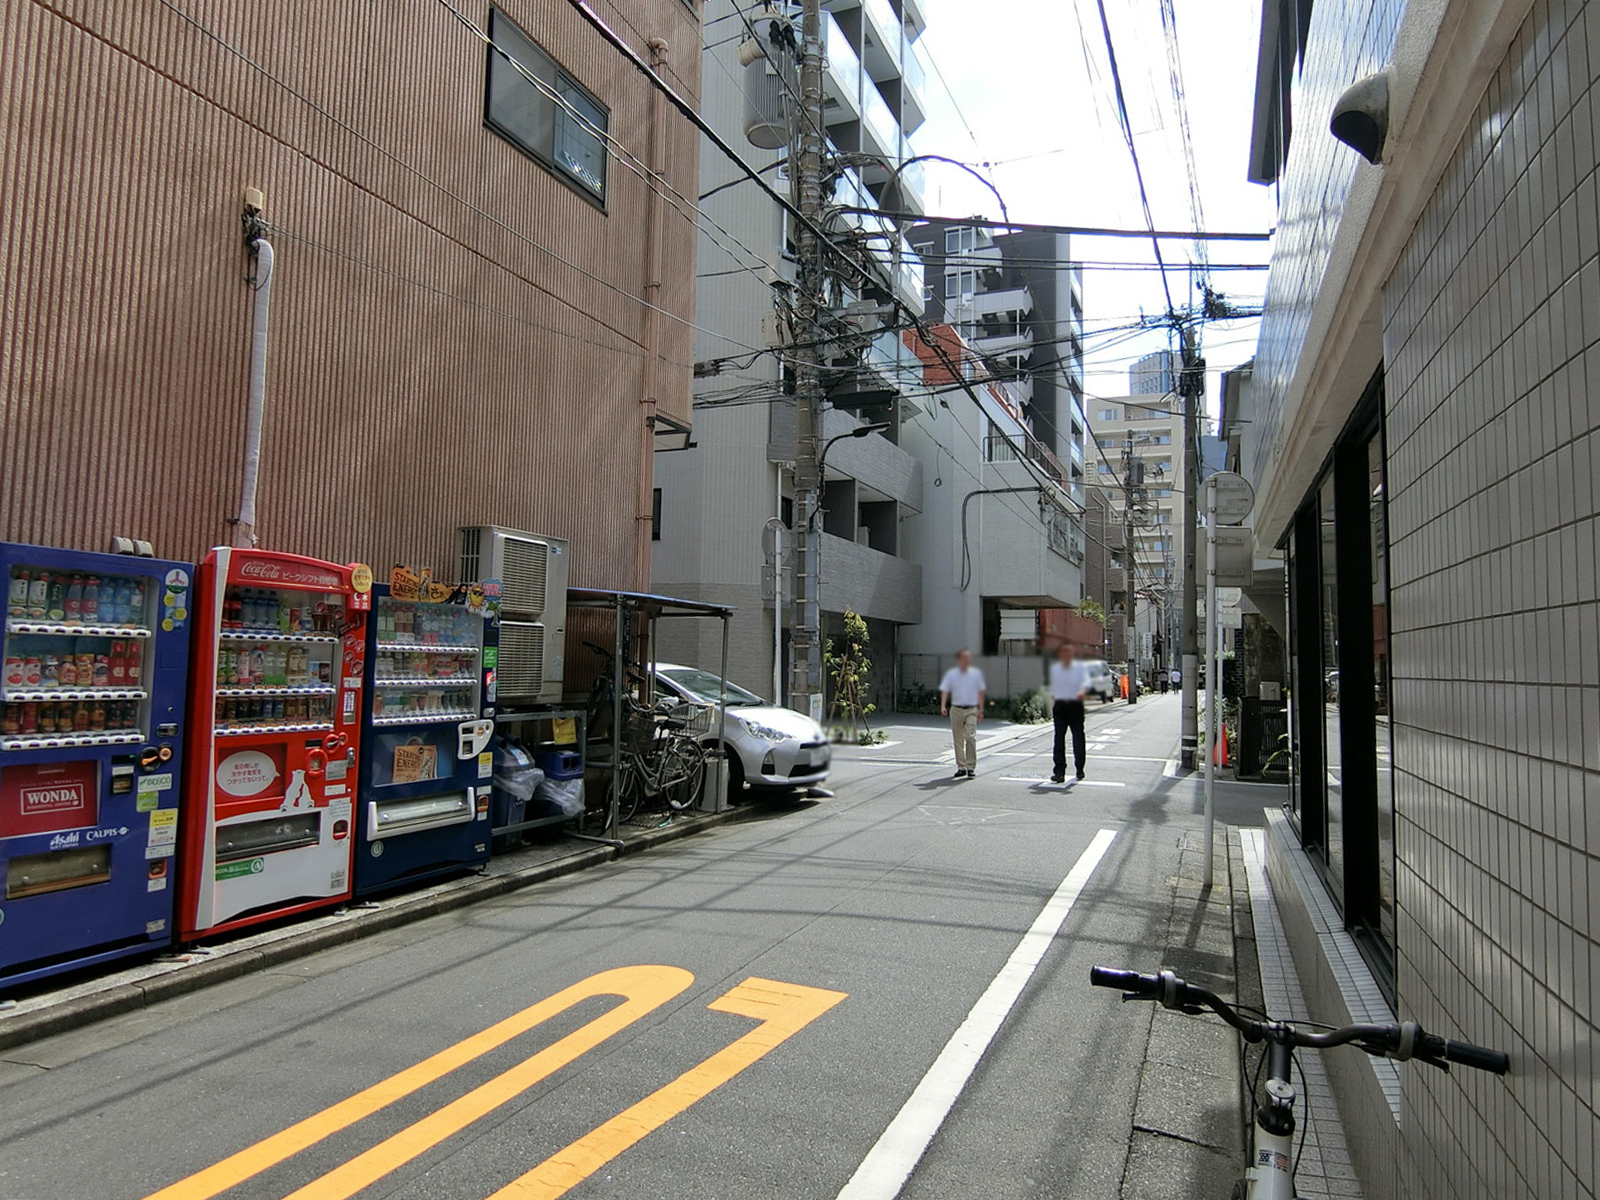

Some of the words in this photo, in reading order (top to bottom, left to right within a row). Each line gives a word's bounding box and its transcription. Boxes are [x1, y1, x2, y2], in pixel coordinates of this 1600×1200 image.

[241, 561, 281, 579] Coca-Cola
[26, 789, 79, 804] WONDA
[50, 831, 80, 847] Asahi
[86, 827, 118, 841] CALPIS
